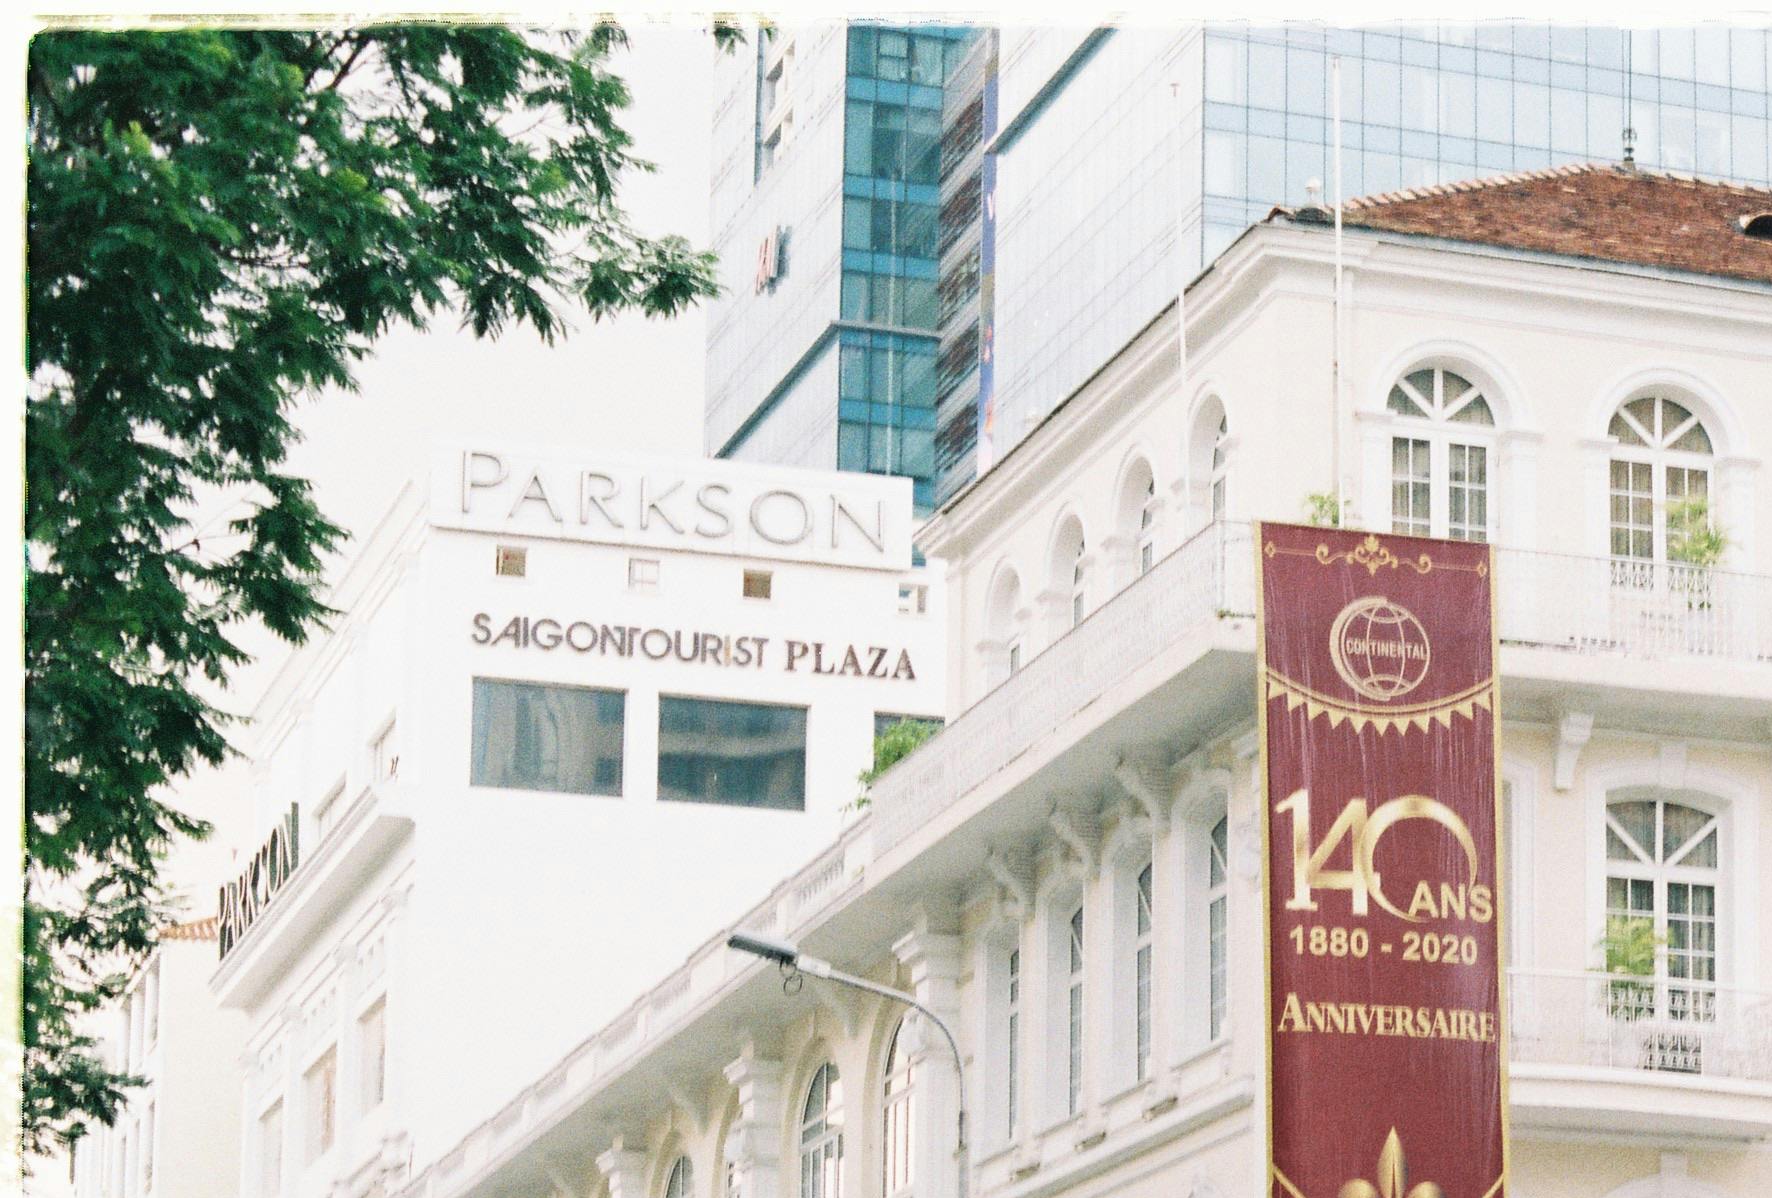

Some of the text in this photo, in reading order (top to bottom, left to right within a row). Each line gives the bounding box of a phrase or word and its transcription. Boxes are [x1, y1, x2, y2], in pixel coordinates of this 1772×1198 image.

[463, 449, 885, 553] PARKSON
[470, 612, 917, 681] SAIGONTOURIST PLAZA
[1345, 636, 1429, 660] CONTINENTAL
[1275, 788, 1493, 924] 140 ANS
[1289, 924, 1368, 959] 1880
[1402, 929, 1478, 966] 2020
[1277, 992, 1496, 1044] ANNIVERSAIRE
